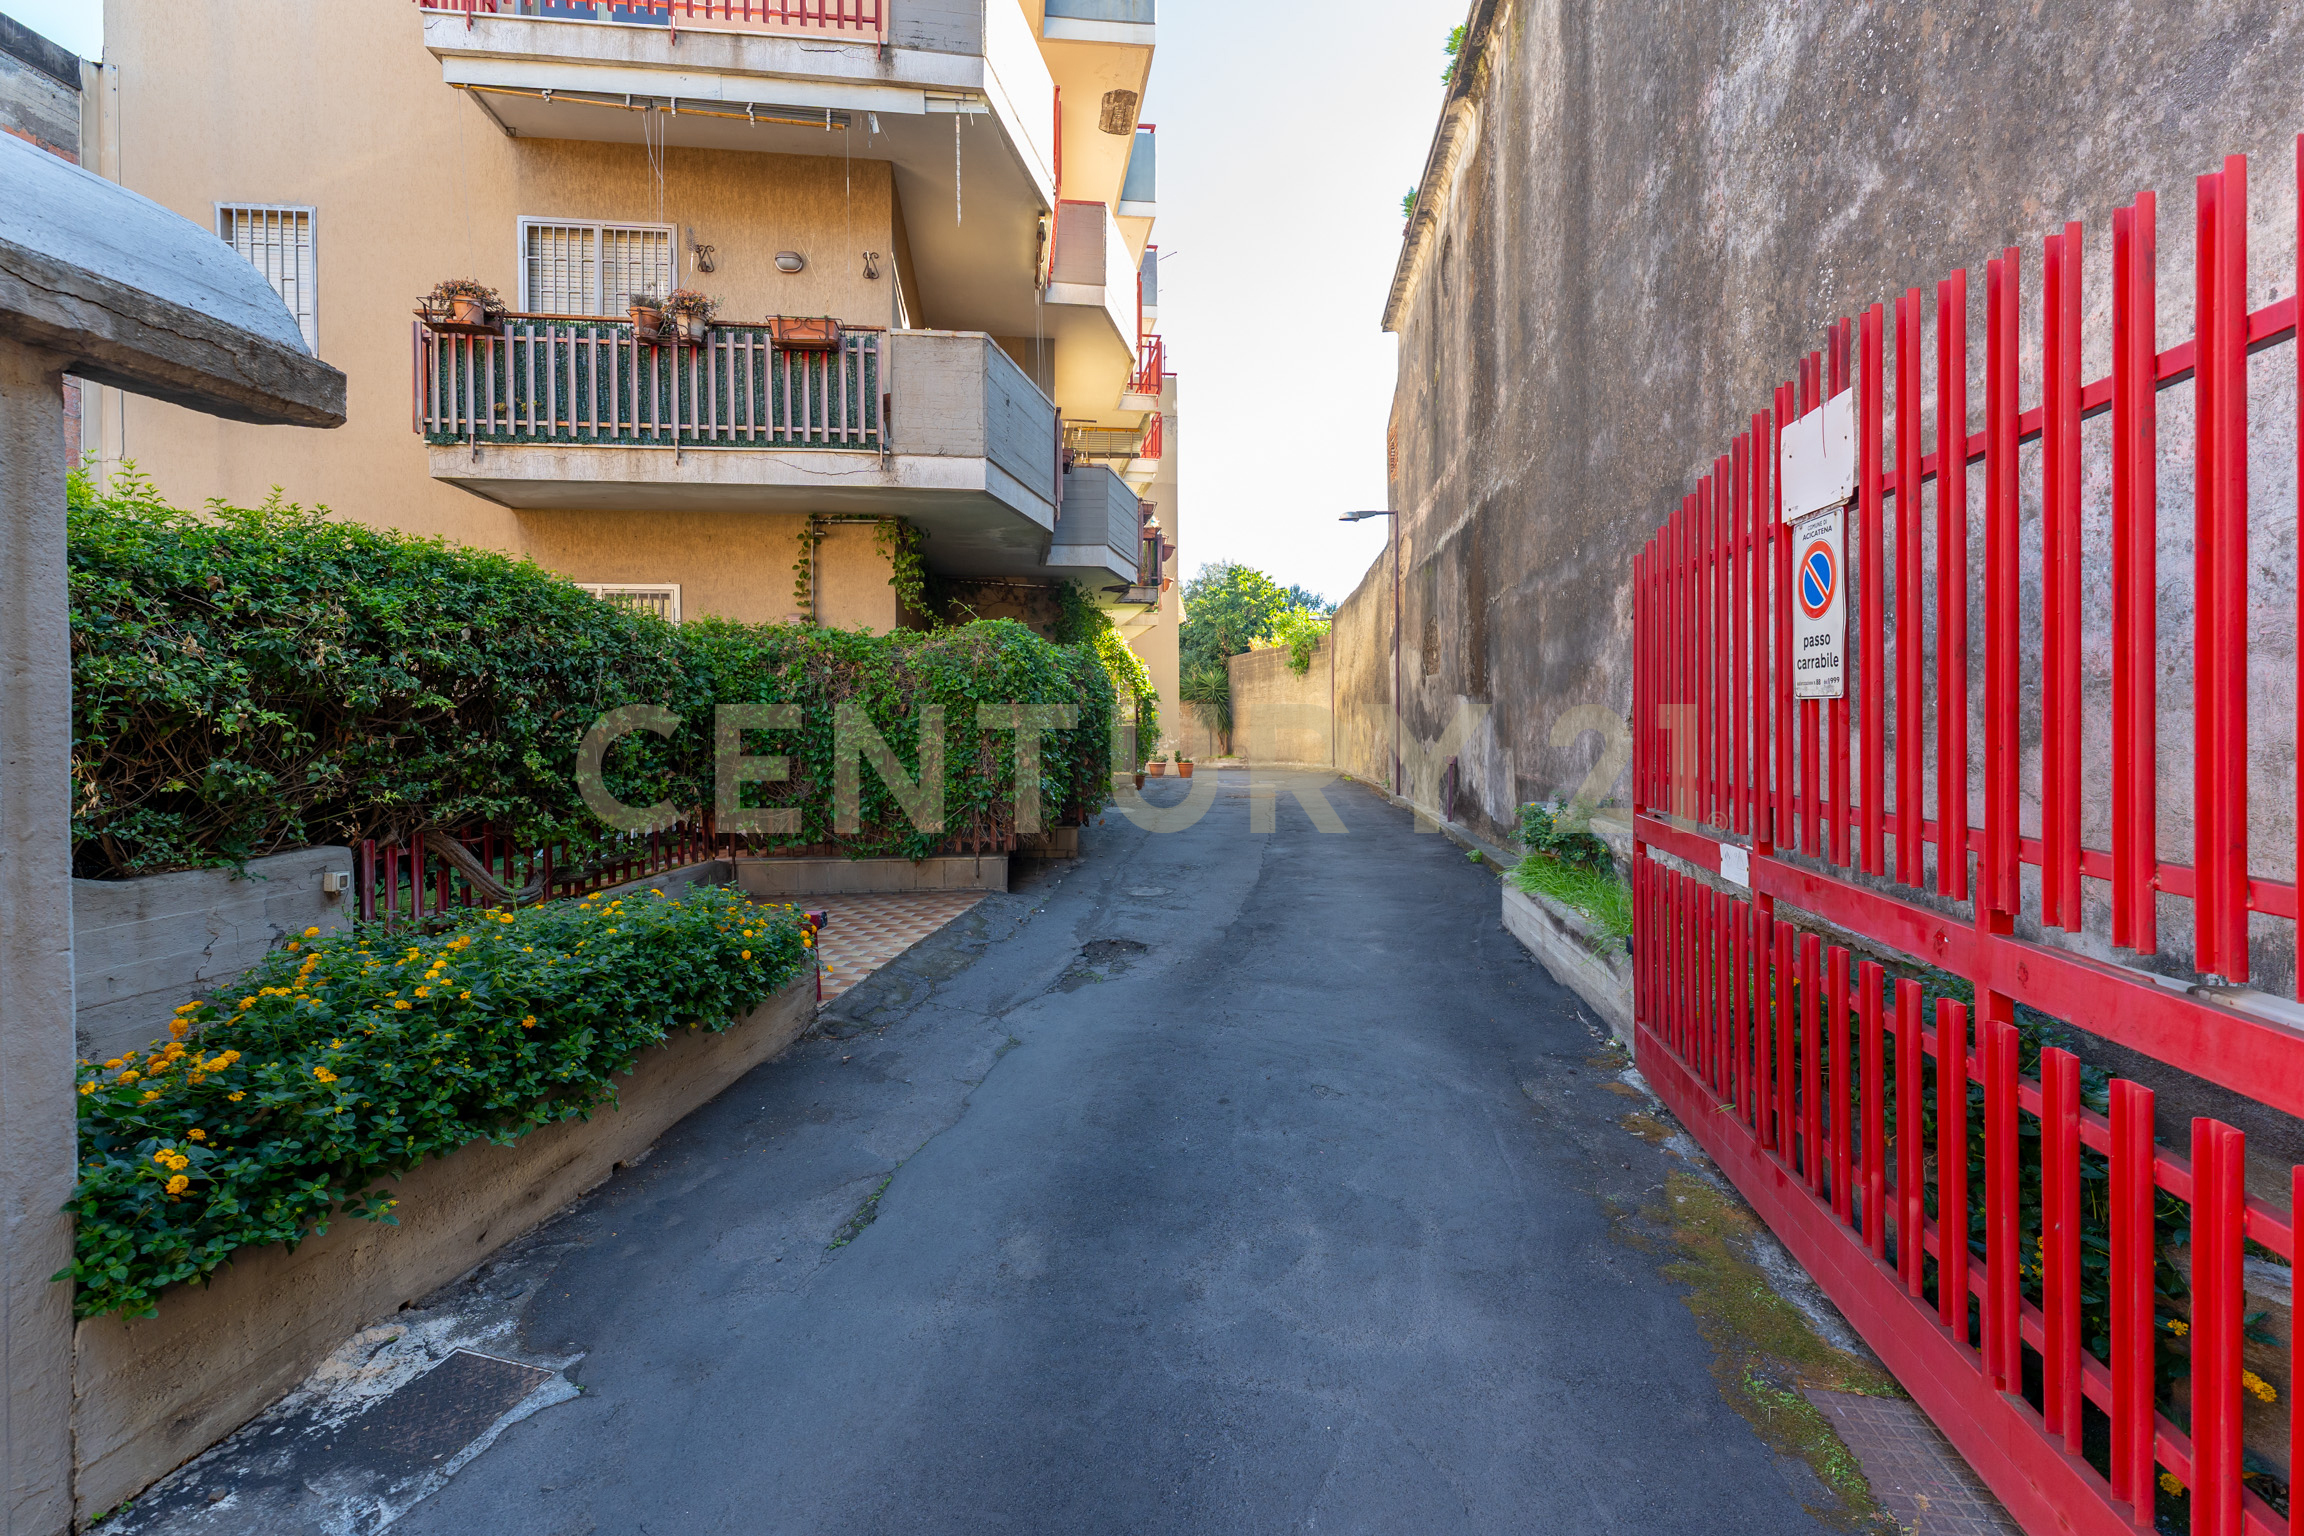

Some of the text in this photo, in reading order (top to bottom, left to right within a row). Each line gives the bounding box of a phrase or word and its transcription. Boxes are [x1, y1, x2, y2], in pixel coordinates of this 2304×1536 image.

[1802, 525, 1833, 541] ACICATENA
[1807, 520, 1823, 531] COMUNE
[1803, 633, 1831, 651] passo
[1796, 652, 1839, 670] carrabile
